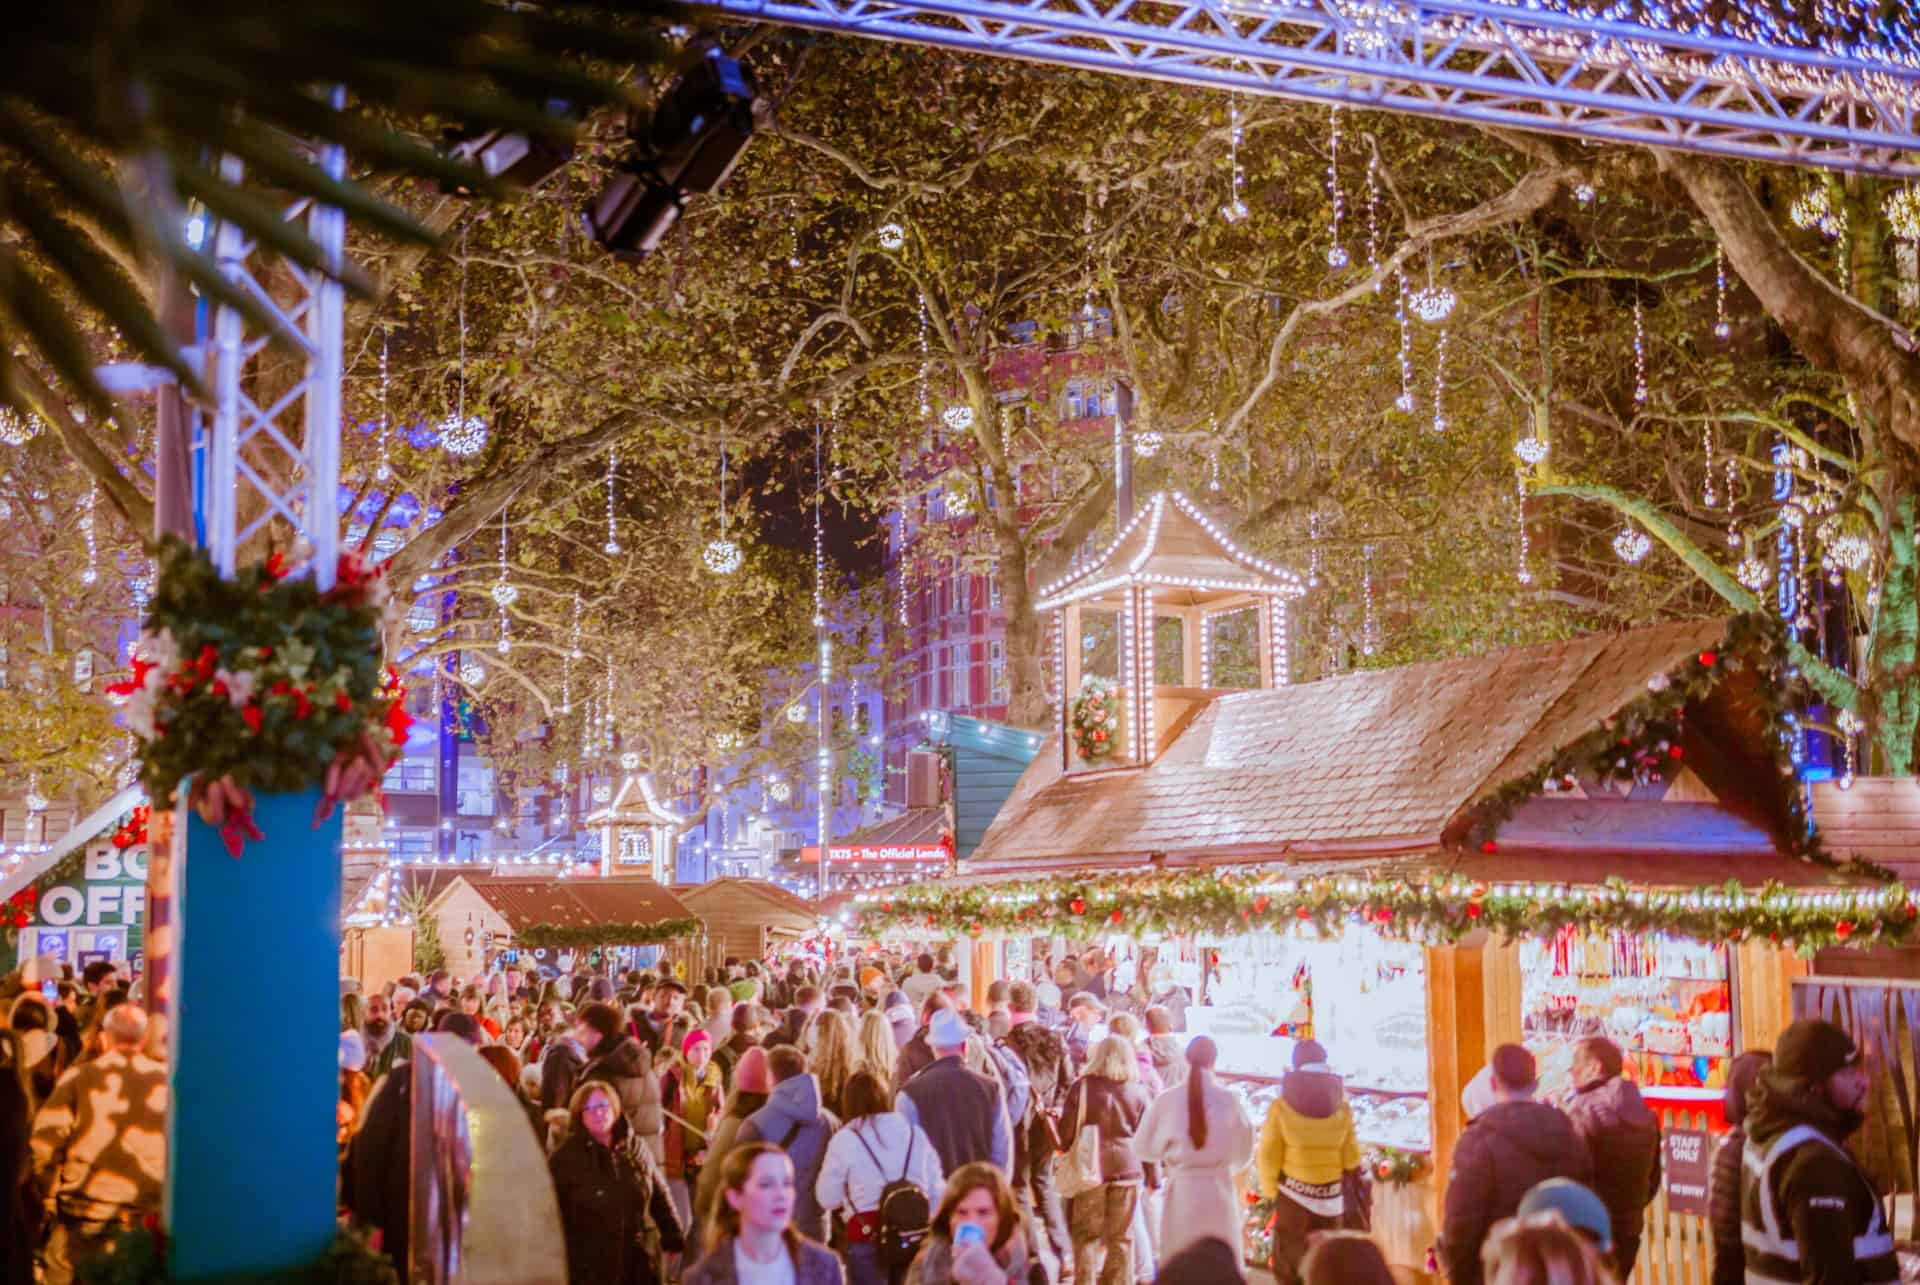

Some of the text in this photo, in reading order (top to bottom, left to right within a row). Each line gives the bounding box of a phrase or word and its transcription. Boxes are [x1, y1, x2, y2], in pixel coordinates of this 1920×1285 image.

[829, 848, 851, 859] TKTS
[861, 848, 878, 859] The
[879, 848, 915, 859] Official
[40, 886, 144, 926] OFF
[1670, 1135, 1701, 1149] STAFF
[1673, 1149, 1699, 1162] ONLY
